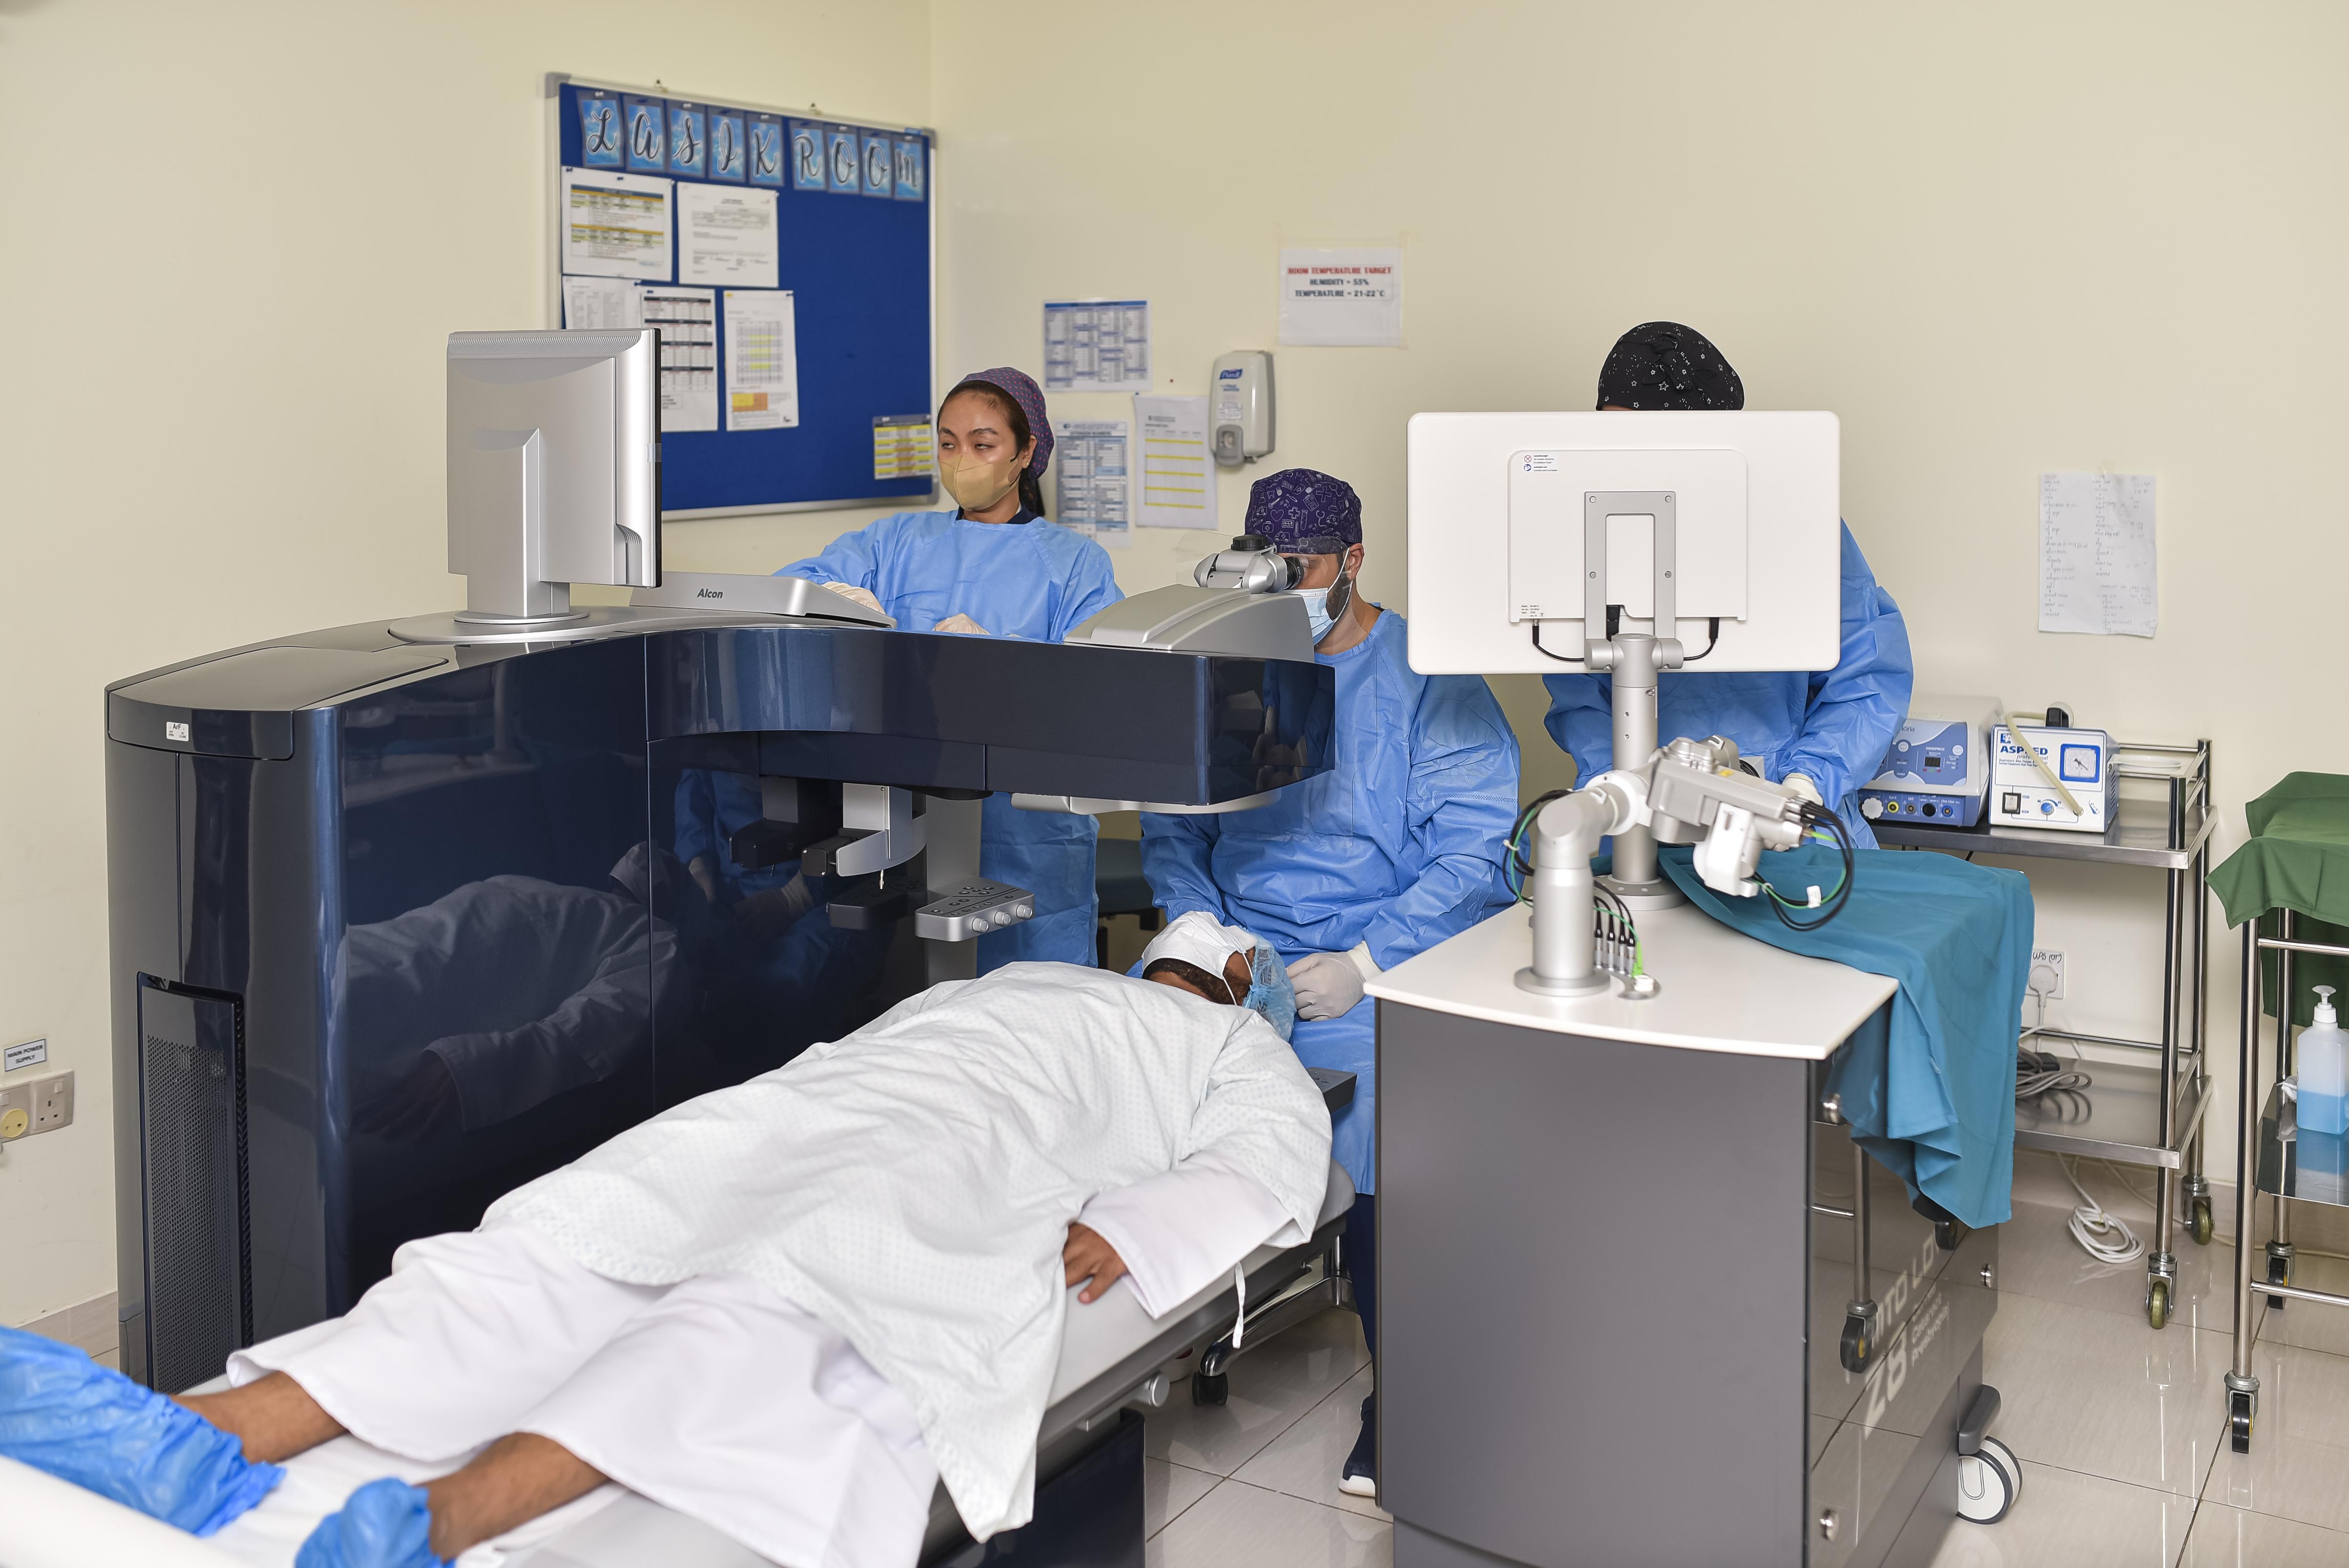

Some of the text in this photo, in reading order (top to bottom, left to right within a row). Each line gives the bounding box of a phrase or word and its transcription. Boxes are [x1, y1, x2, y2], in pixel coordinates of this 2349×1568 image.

[586, 107, 779, 178] LASIK
[696, 588, 723, 598] Alcon
[2000, 745, 2048, 755] ASPED
[16, 1055, 35, 1063] SUPPLY
[23, 1045, 43, 1053] POWER
[1912, 1292, 1942, 1345] Cataract
[1912, 1304, 1948, 1367] Presbyopia
[1864, 1321, 1907, 1440] Z8
